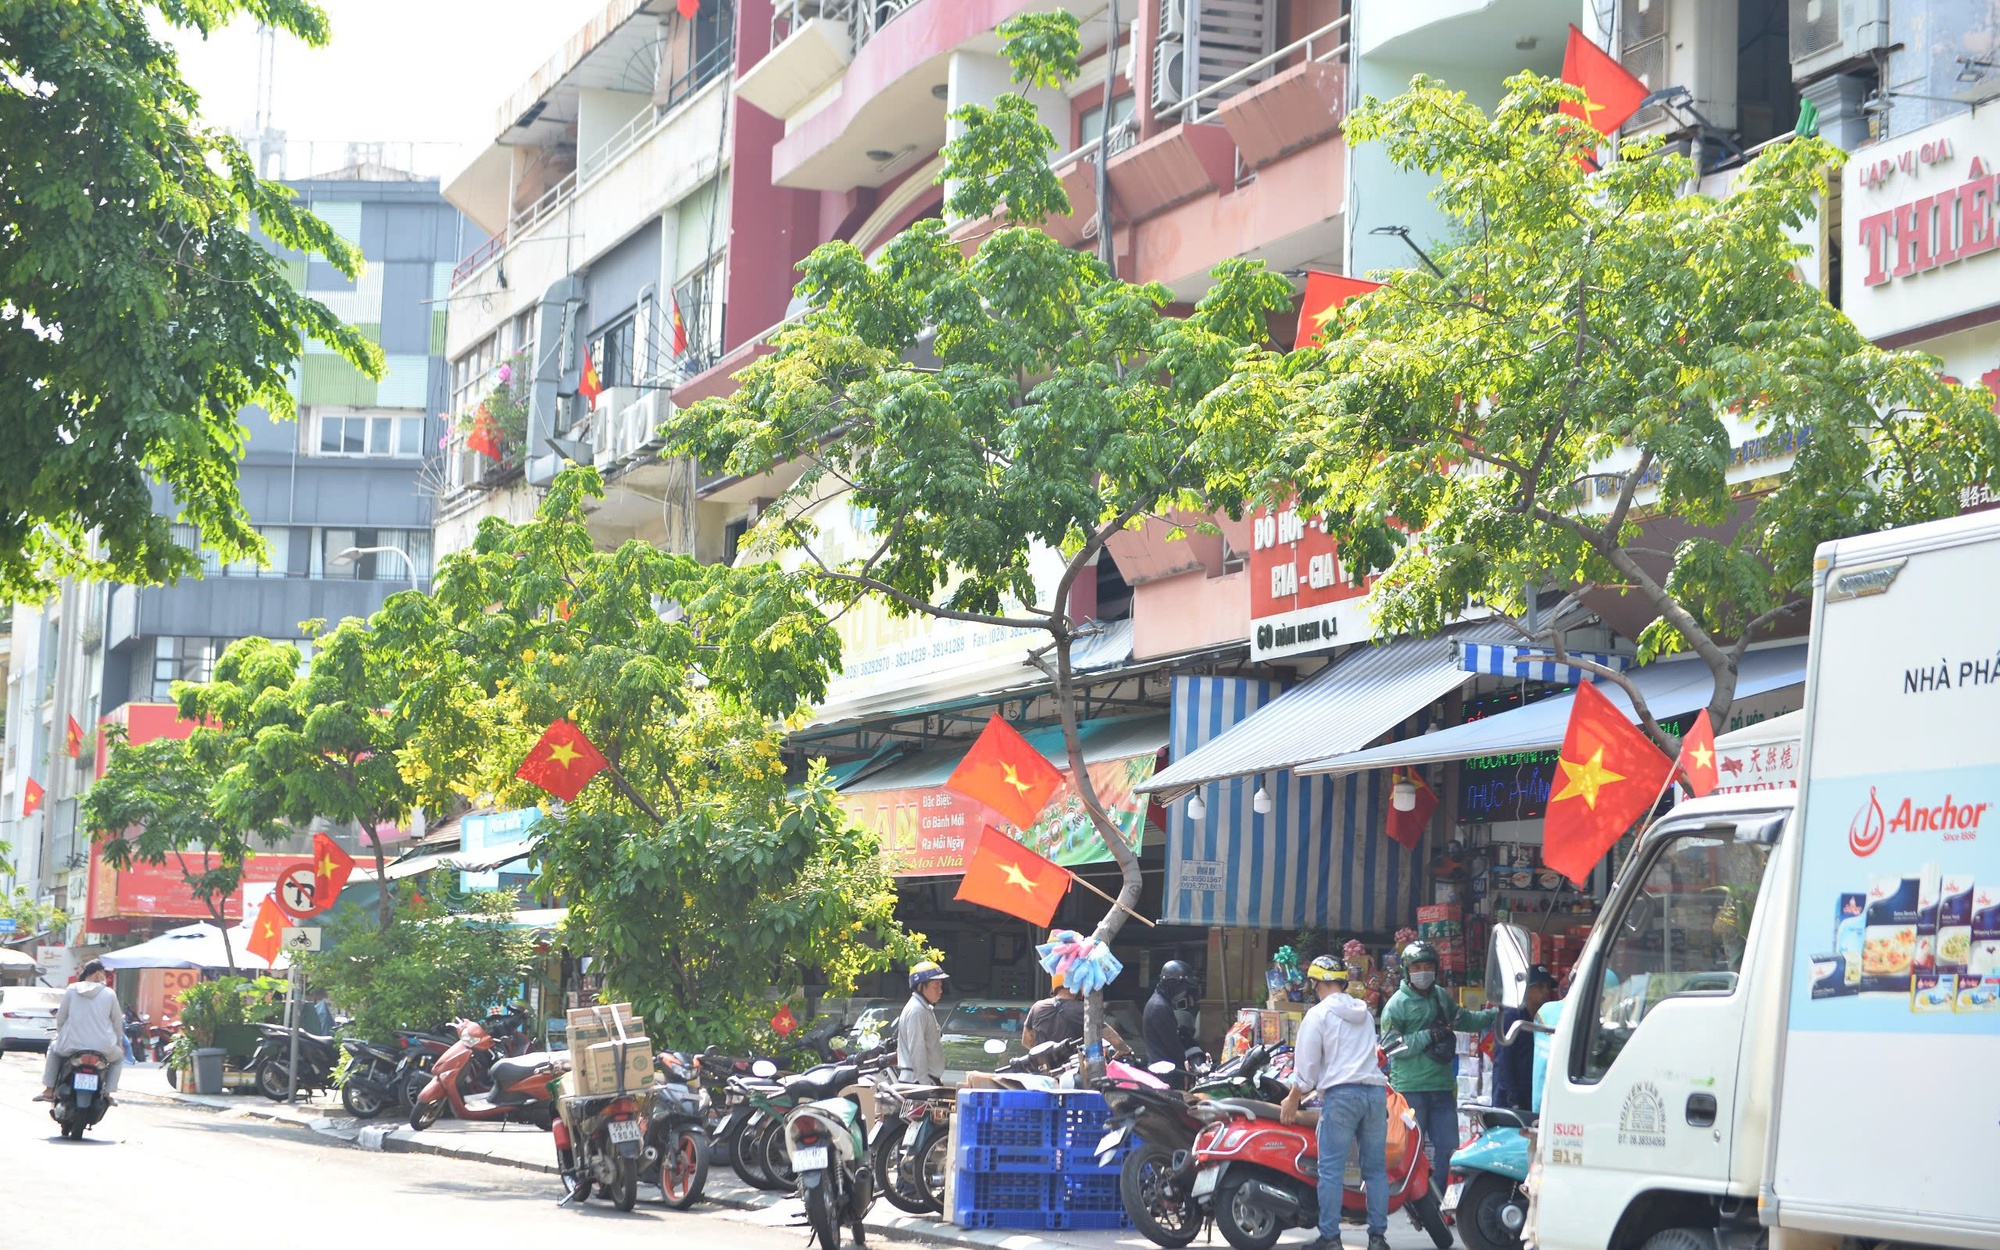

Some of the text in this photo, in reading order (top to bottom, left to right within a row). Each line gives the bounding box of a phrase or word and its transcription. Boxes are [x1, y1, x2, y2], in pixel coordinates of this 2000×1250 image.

[1919, 137, 1948, 165] GIA
[1859, 155, 2000, 288] THIÊ
[1271, 562, 1299, 599] BIA
[1309, 553, 1336, 590] GIA
[932, 635, 966, 659] 39141289
[972, 631, 987, 648] Fax:
[988, 626, 1008, 645] (028)
[1257, 623, 1274, 650] 60
[1321, 616, 1338, 640] Q.1
[1904, 657, 1951, 694] NHÀ
[1749, 744, 1800, 772] 天然燒
[923, 793, 953, 810] Đặc Biệt:
[1887, 794, 1987, 833] Anchor
[922, 812, 965, 829] Có Bánh Mới
[921, 833, 965, 852] Ra Mỗi Ngày
[1942, 832, 1960, 842] Since
[936, 854, 963, 868] Nhà
[1553, 1122, 1584, 1136] ISUZU
